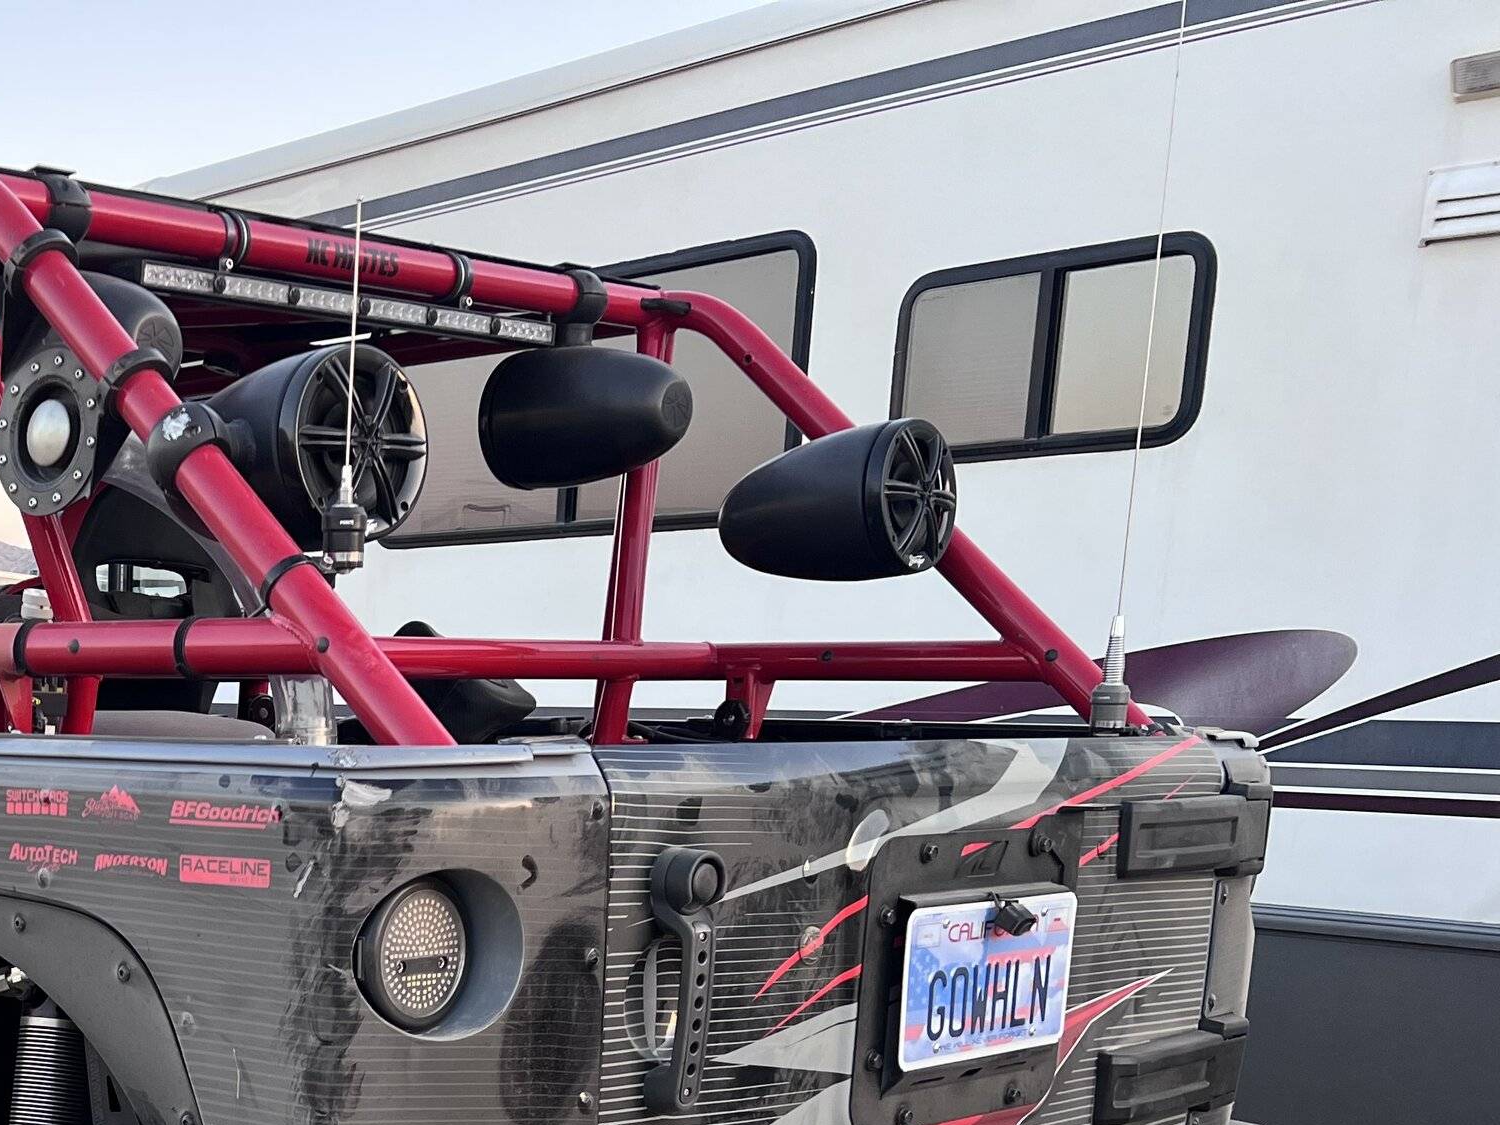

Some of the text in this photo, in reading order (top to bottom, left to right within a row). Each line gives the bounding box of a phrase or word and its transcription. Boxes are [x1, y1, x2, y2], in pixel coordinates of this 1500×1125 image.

[171, 799, 281, 825] BFGoodrich
[94, 853, 169, 877] ANDERSON
[181, 857, 268, 877] RACELINE
[926, 954, 1051, 1042] GOWHLN
